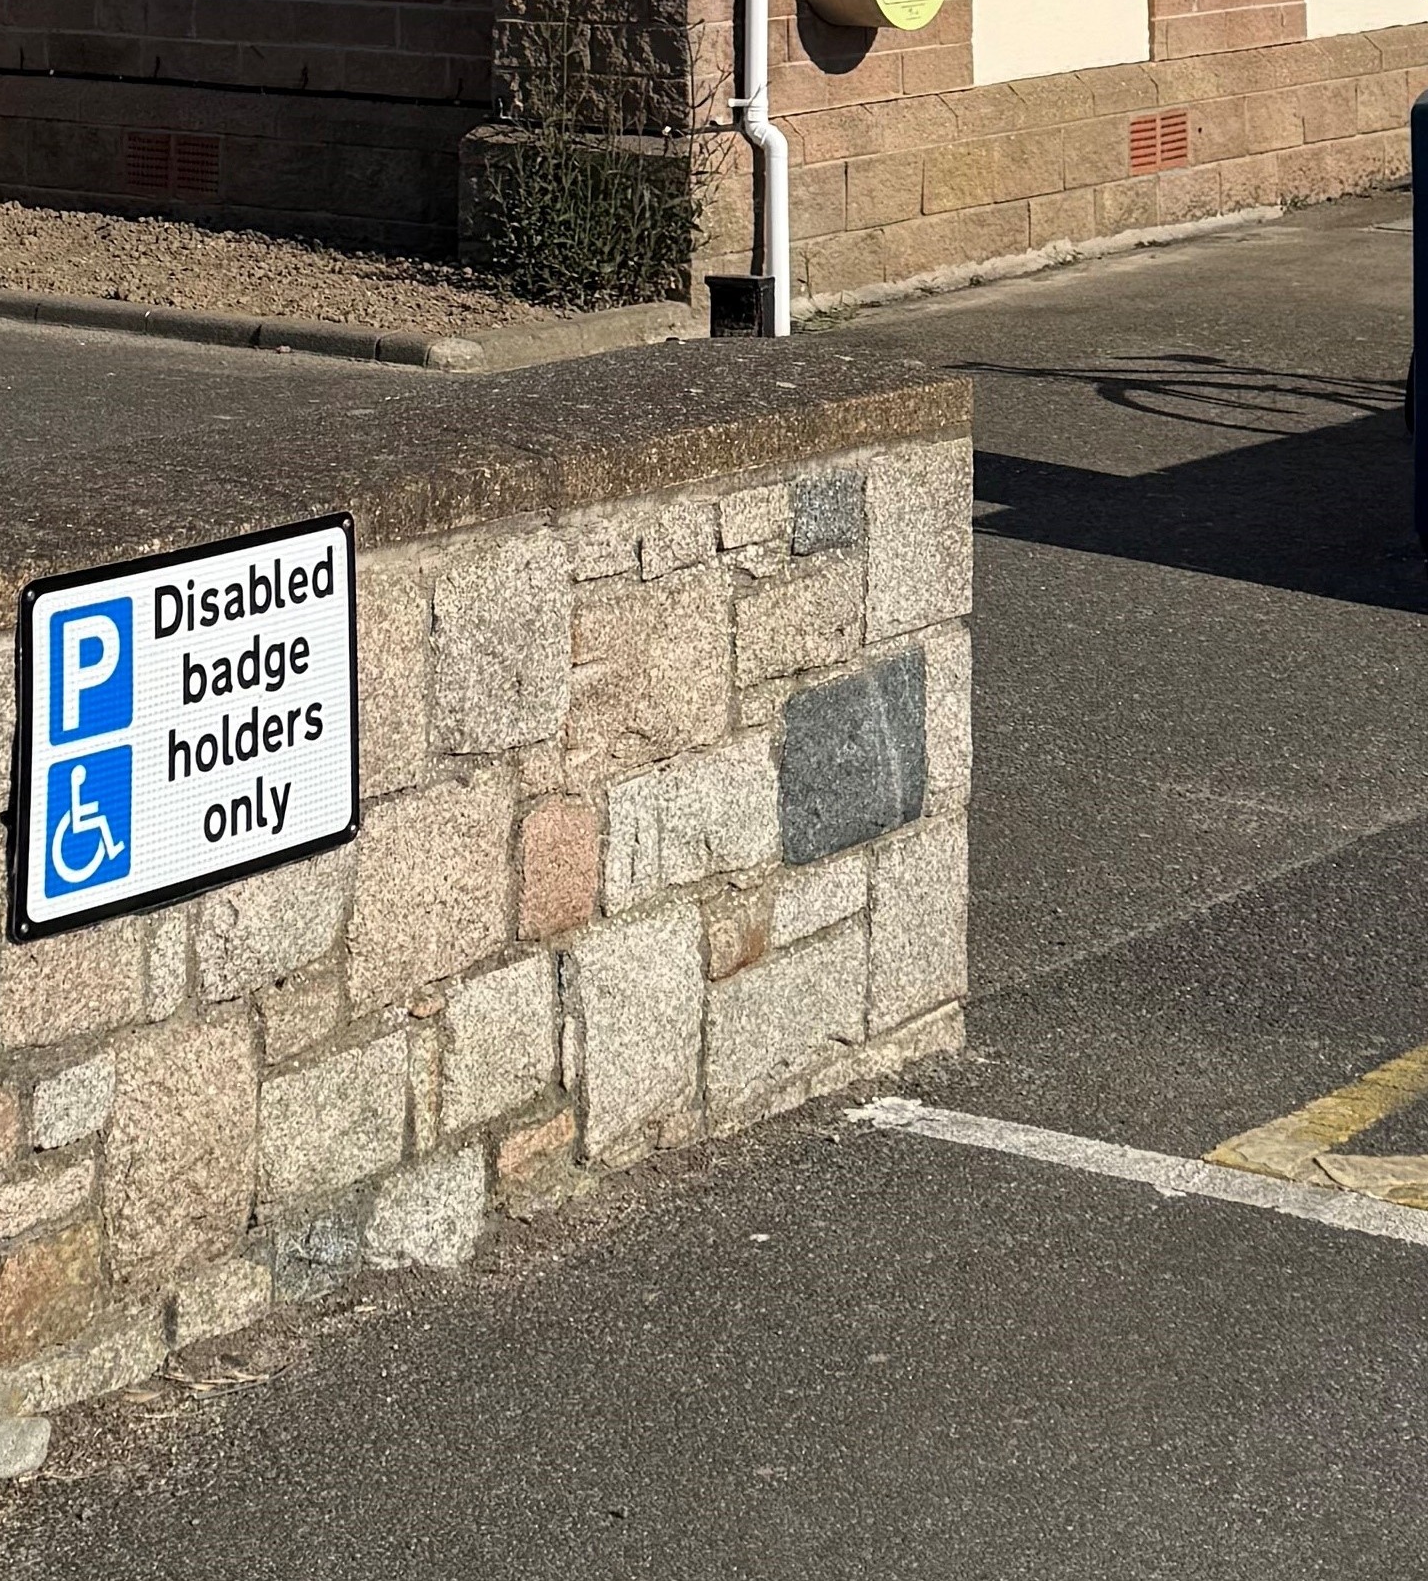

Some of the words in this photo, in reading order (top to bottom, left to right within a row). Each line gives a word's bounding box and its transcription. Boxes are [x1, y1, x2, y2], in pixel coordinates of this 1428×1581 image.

[154, 545, 334, 640] Disabled
[62, 614, 121, 733] P
[182, 634, 310, 705] badge
[167, 700, 324, 782] holders
[203, 775, 291, 843] only
